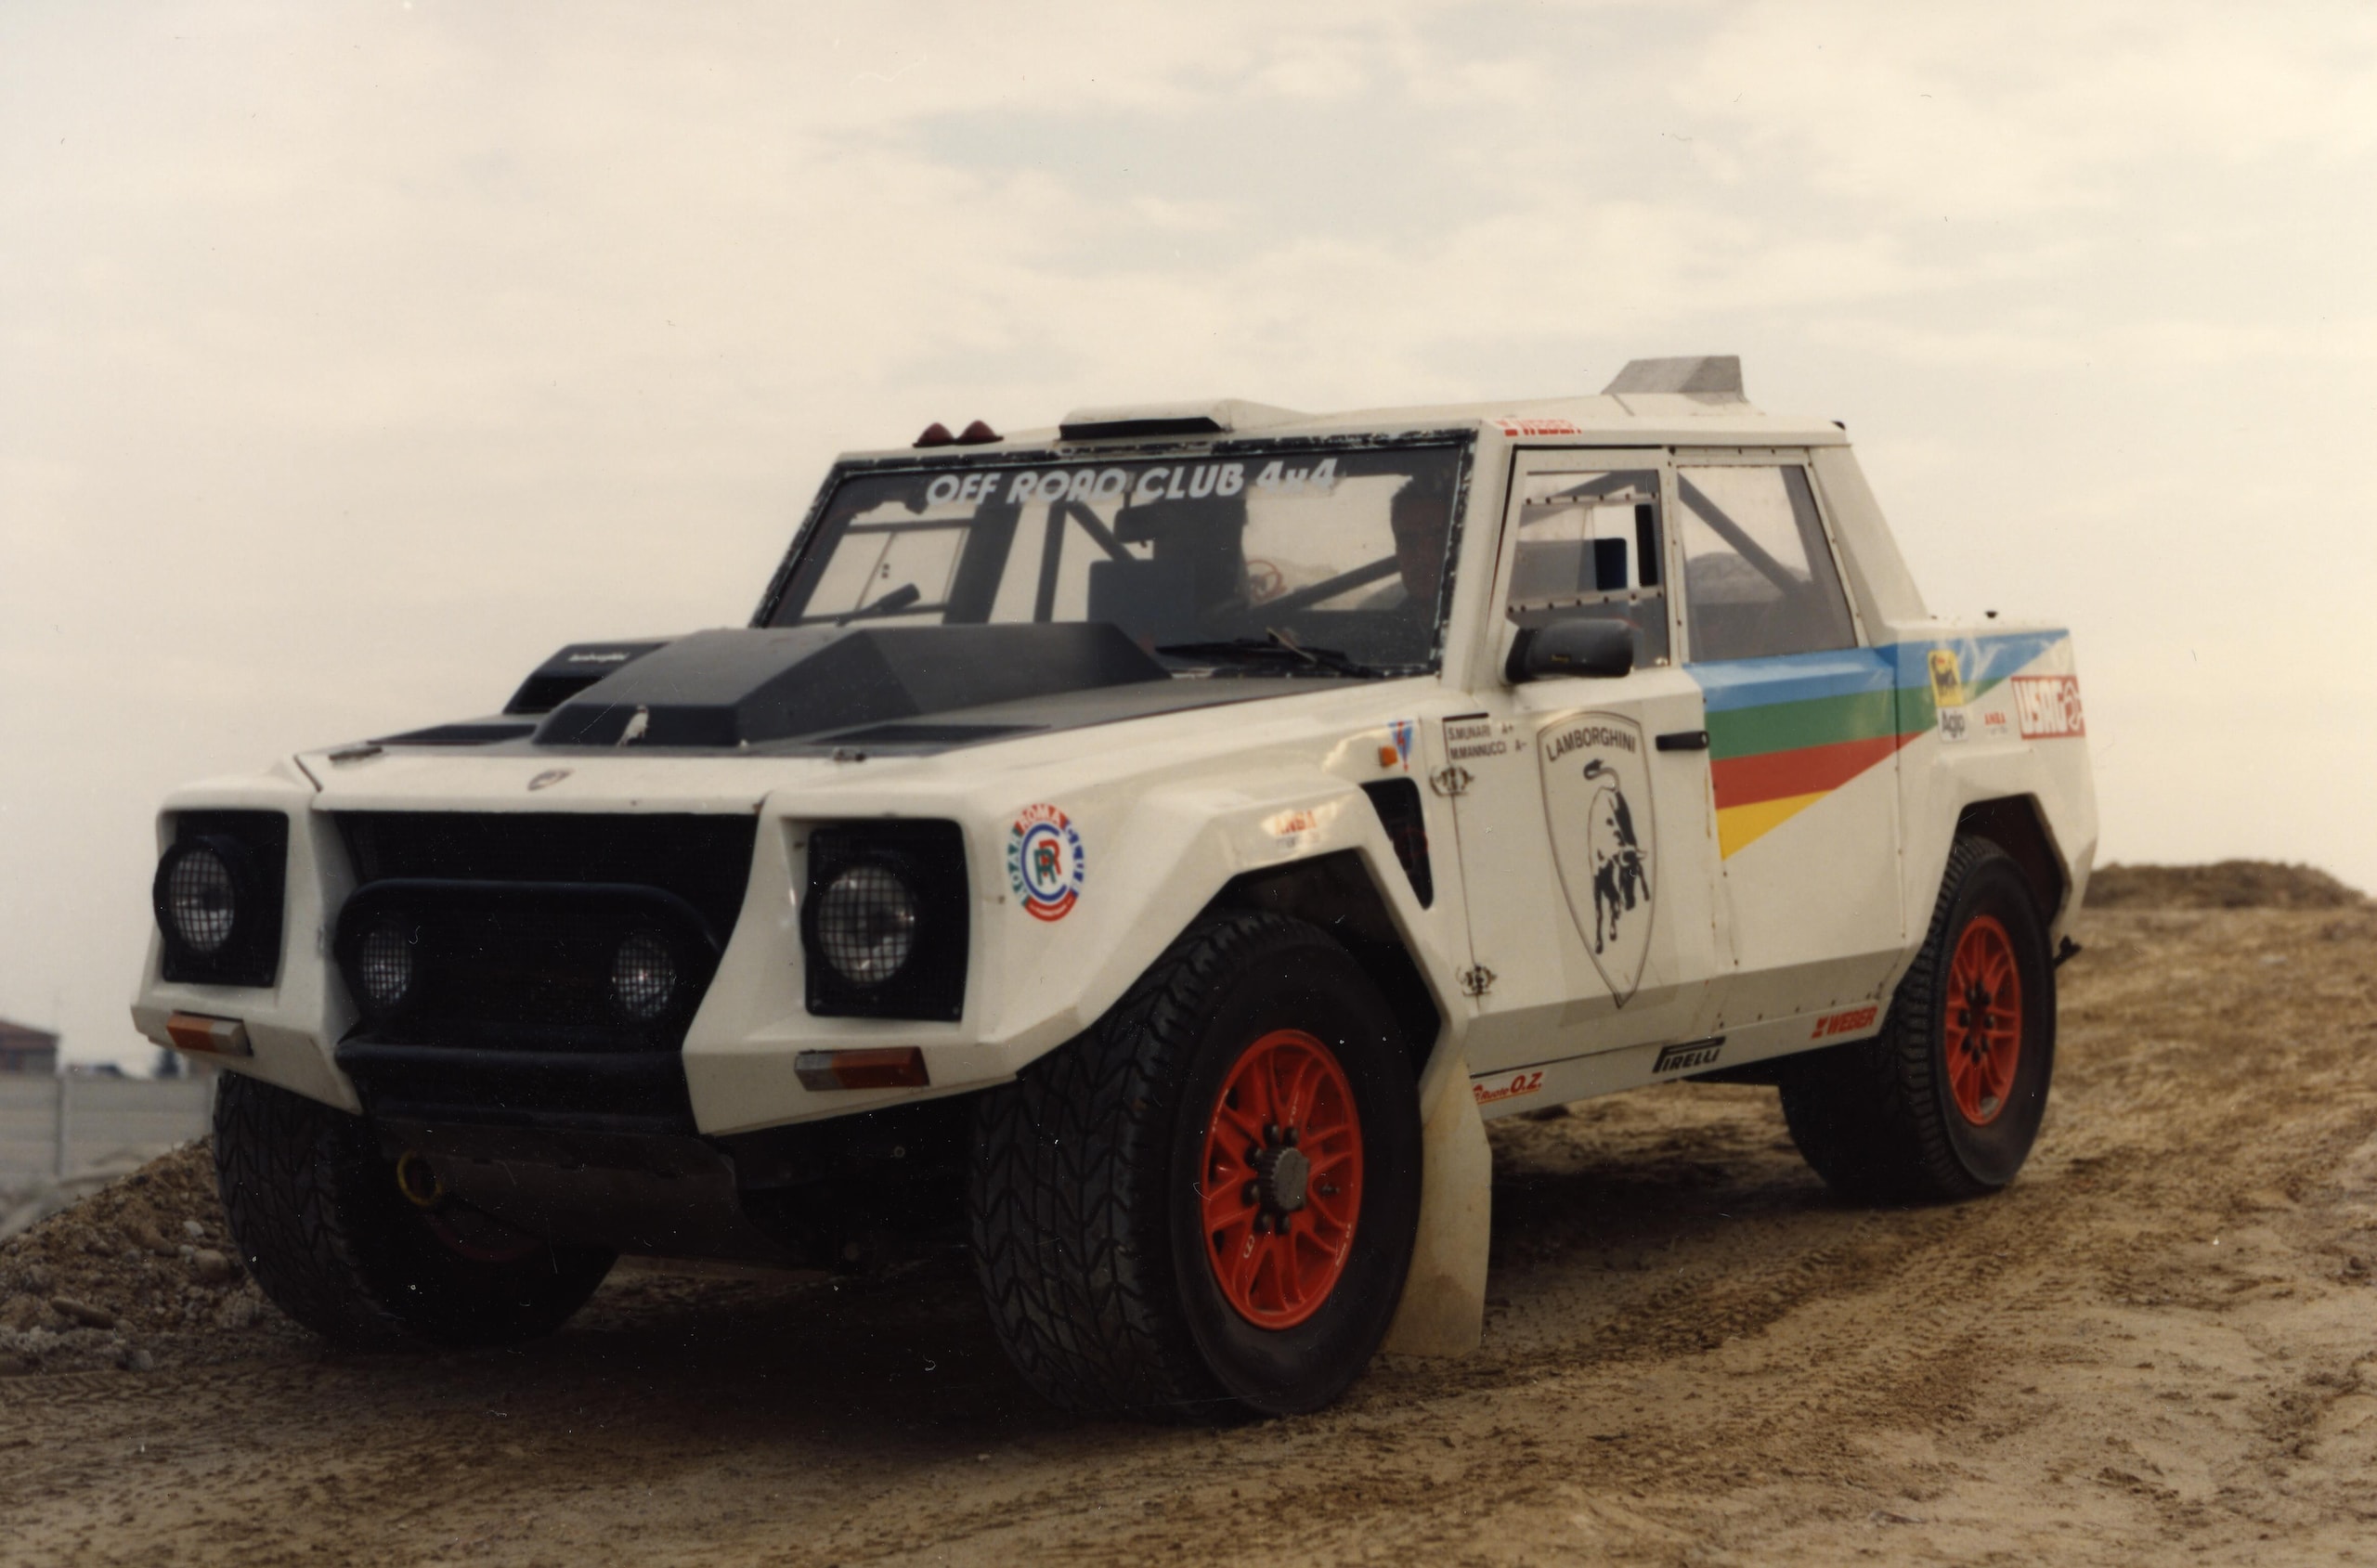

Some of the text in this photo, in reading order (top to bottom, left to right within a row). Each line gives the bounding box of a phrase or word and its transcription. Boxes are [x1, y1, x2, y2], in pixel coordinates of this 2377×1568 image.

[927, 472, 1002, 507] OFF
[1007, 467, 1127, 504] ROAD
[1136, 462, 1246, 500] CLUB
[1546, 727, 1636, 763] LAMBORGHINI
[1827, 1004, 1878, 1035] WEBER
[1652, 1035, 1725, 1073] PIRELLI
